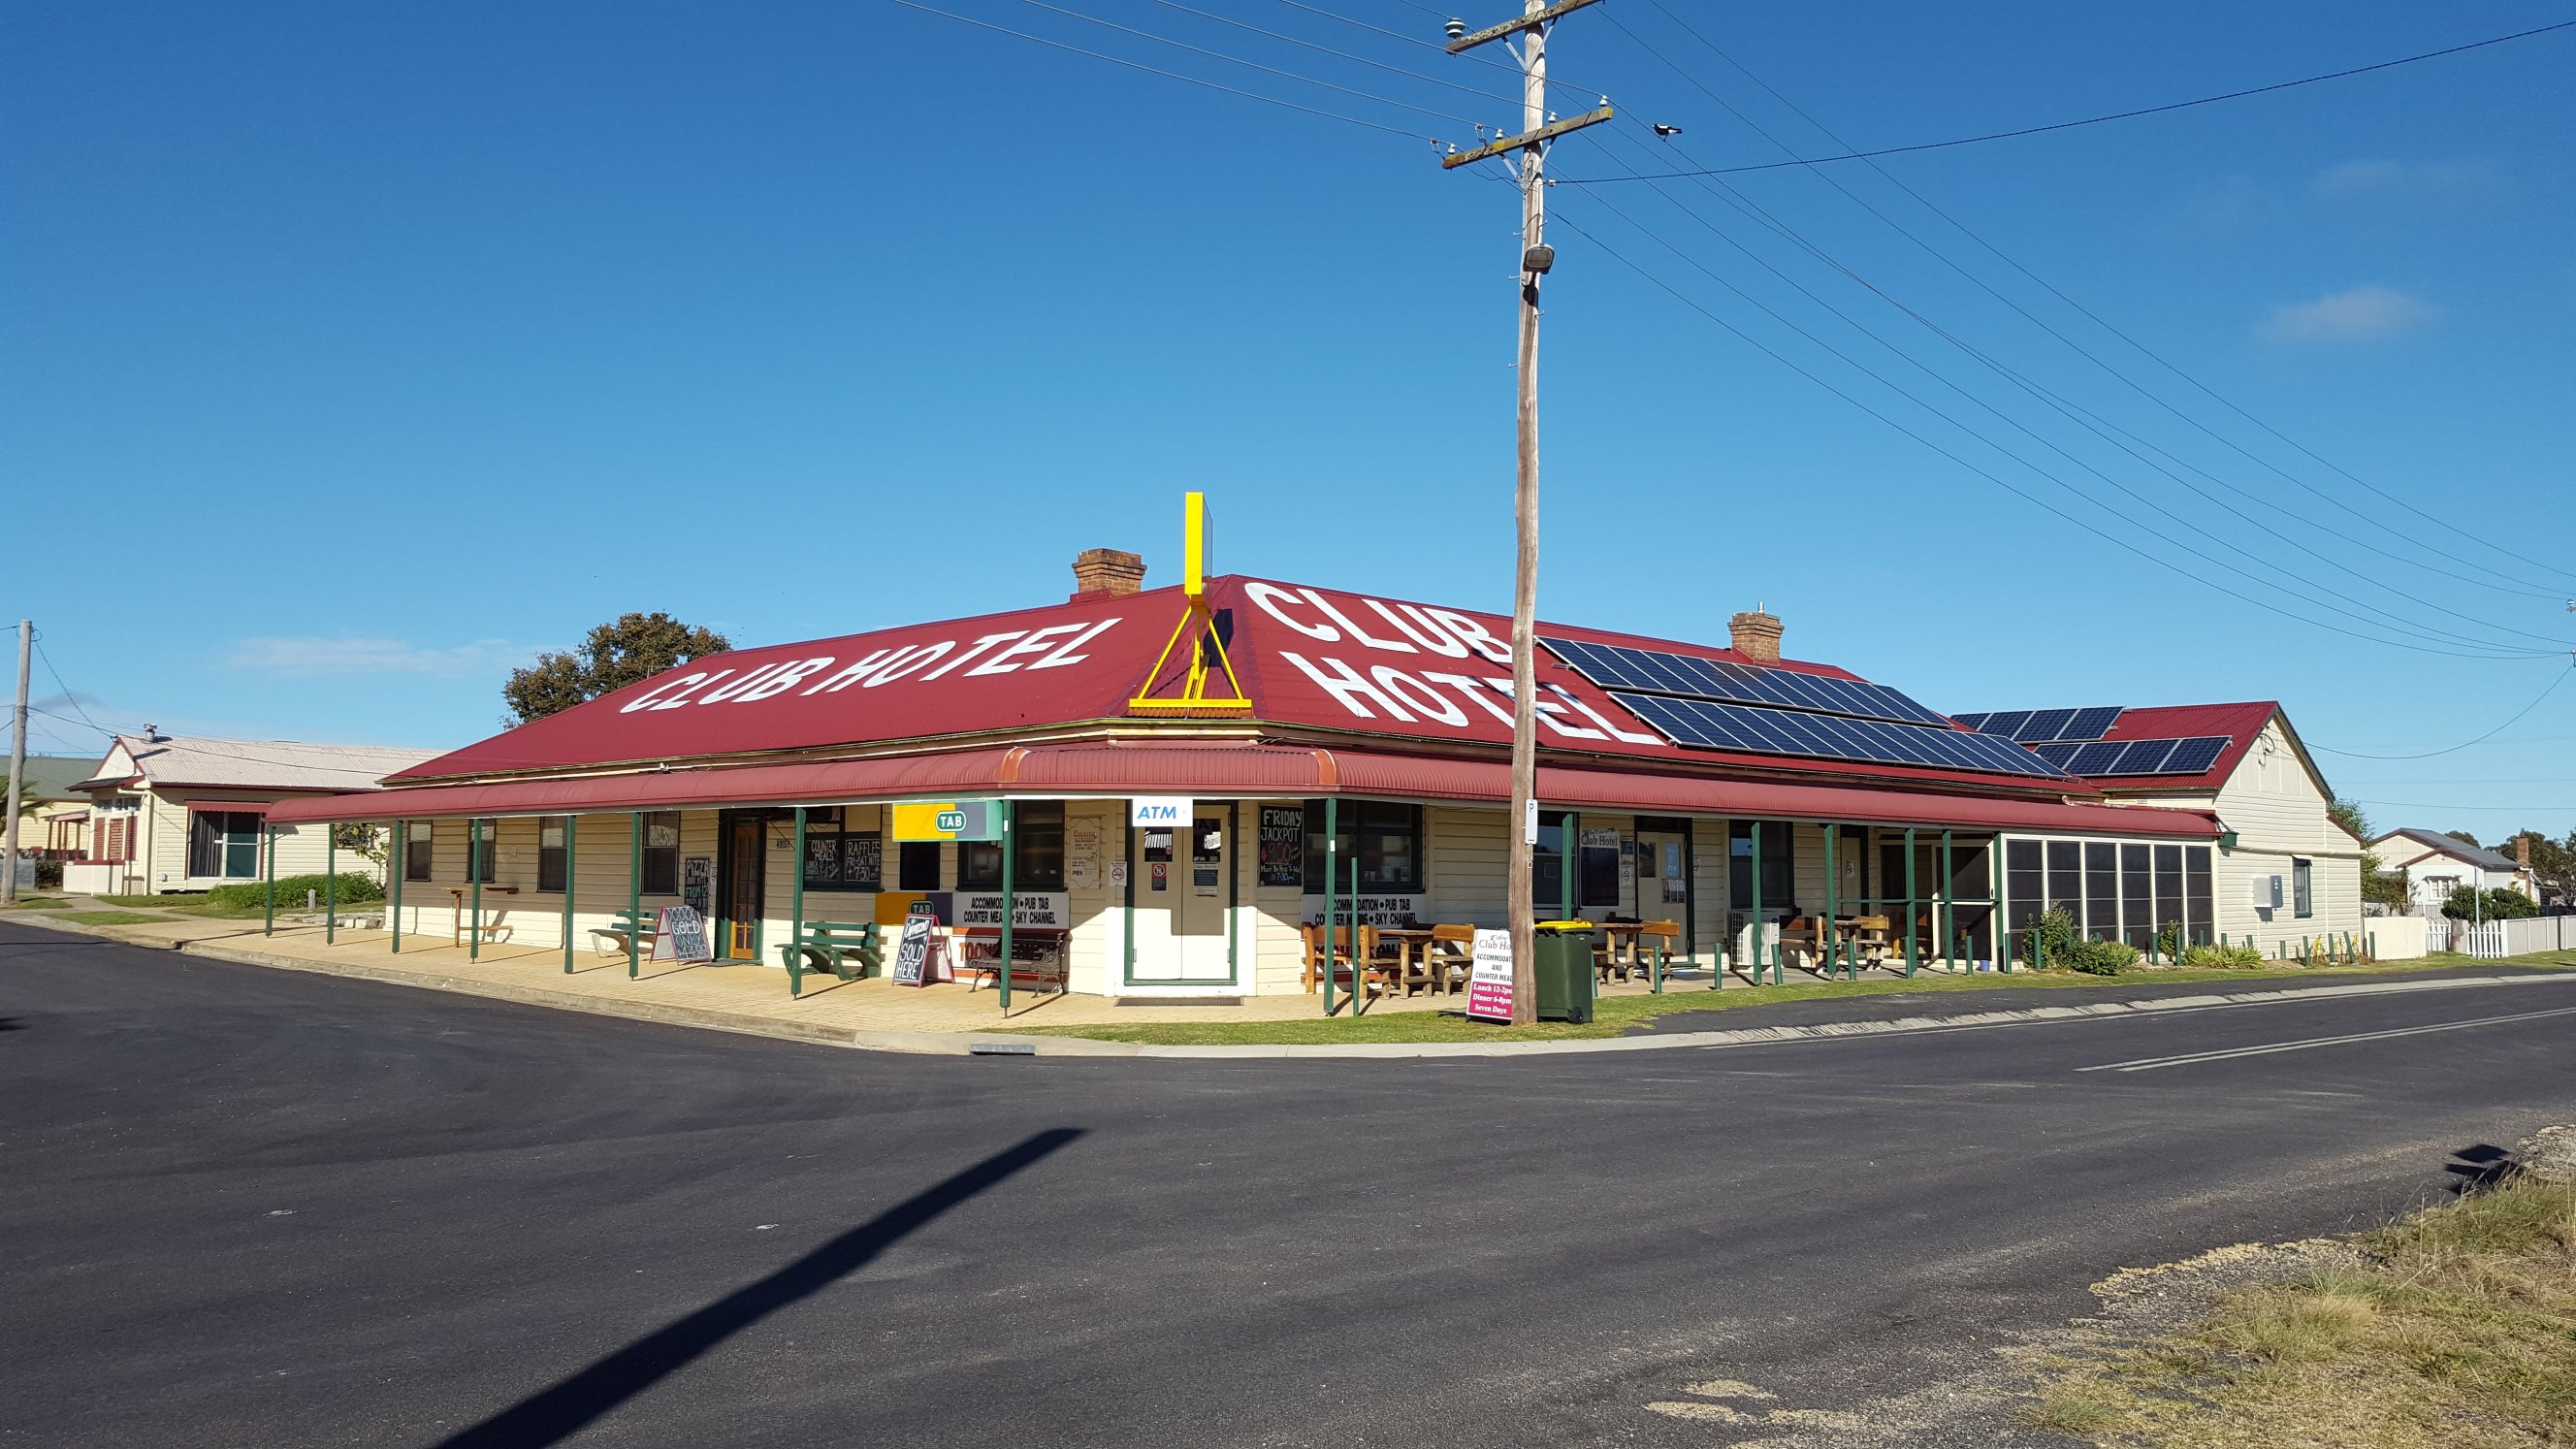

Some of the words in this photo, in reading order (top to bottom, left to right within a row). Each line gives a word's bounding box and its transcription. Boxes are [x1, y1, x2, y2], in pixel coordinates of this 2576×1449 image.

[1244, 582, 1513, 664] CLUB
[620, 656, 836, 714] CLUB
[799, 617, 1124, 696] HOTEL
[1278, 651, 1669, 746] HOTEL
[1137, 806, 1176, 820] ATM
[1263, 809, 1303, 827] FRIDAY
[940, 816, 963, 826] TAB
[1260, 826, 1301, 843] JACKPOT
[1582, 834, 1597, 846] Club
[1598, 835, 1618, 847] Hotel
[811, 840, 837, 853] COUNTER
[848, 841, 881, 856] RAFFLES
[815, 851, 834, 861] MEALS
[913, 905, 931, 914] TAB
[971, 897, 1019, 910] ACCOMMODON
[1024, 897, 1037, 910] PUB
[1038, 897, 1049, 910] TAB
[1324, 898, 1379, 912] COMMDATION
[1385, 898, 1397, 911] PUB
[1400, 898, 1411, 911] TAB
[963, 911, 989, 923] COUNTER
[990, 911, 1004, 923] MEA
[1015, 912, 1028, 924] SKY
[1029, 912, 1056, 924] CHANNEL
[1374, 913, 1388, 925] SKY
[675, 933, 702, 947] ONLY
[1478, 939, 1497, 950] Club
[899, 943, 924, 963] SOLD
[1476, 952, 1513, 963] ACCOMMODAT
[895, 961, 920, 980] HERE
[1474, 971, 1498, 981] COUNTER
[1498, 974, 1513, 982] MEAL
[1473, 982, 1492, 992] Lunch
[1472, 992, 1493, 1002] Dinner
[1494, 996, 1512, 1006] 6-8pm
[1474, 1003, 1492, 1013] Seven
[1492, 1005, 1507, 1015] Days
